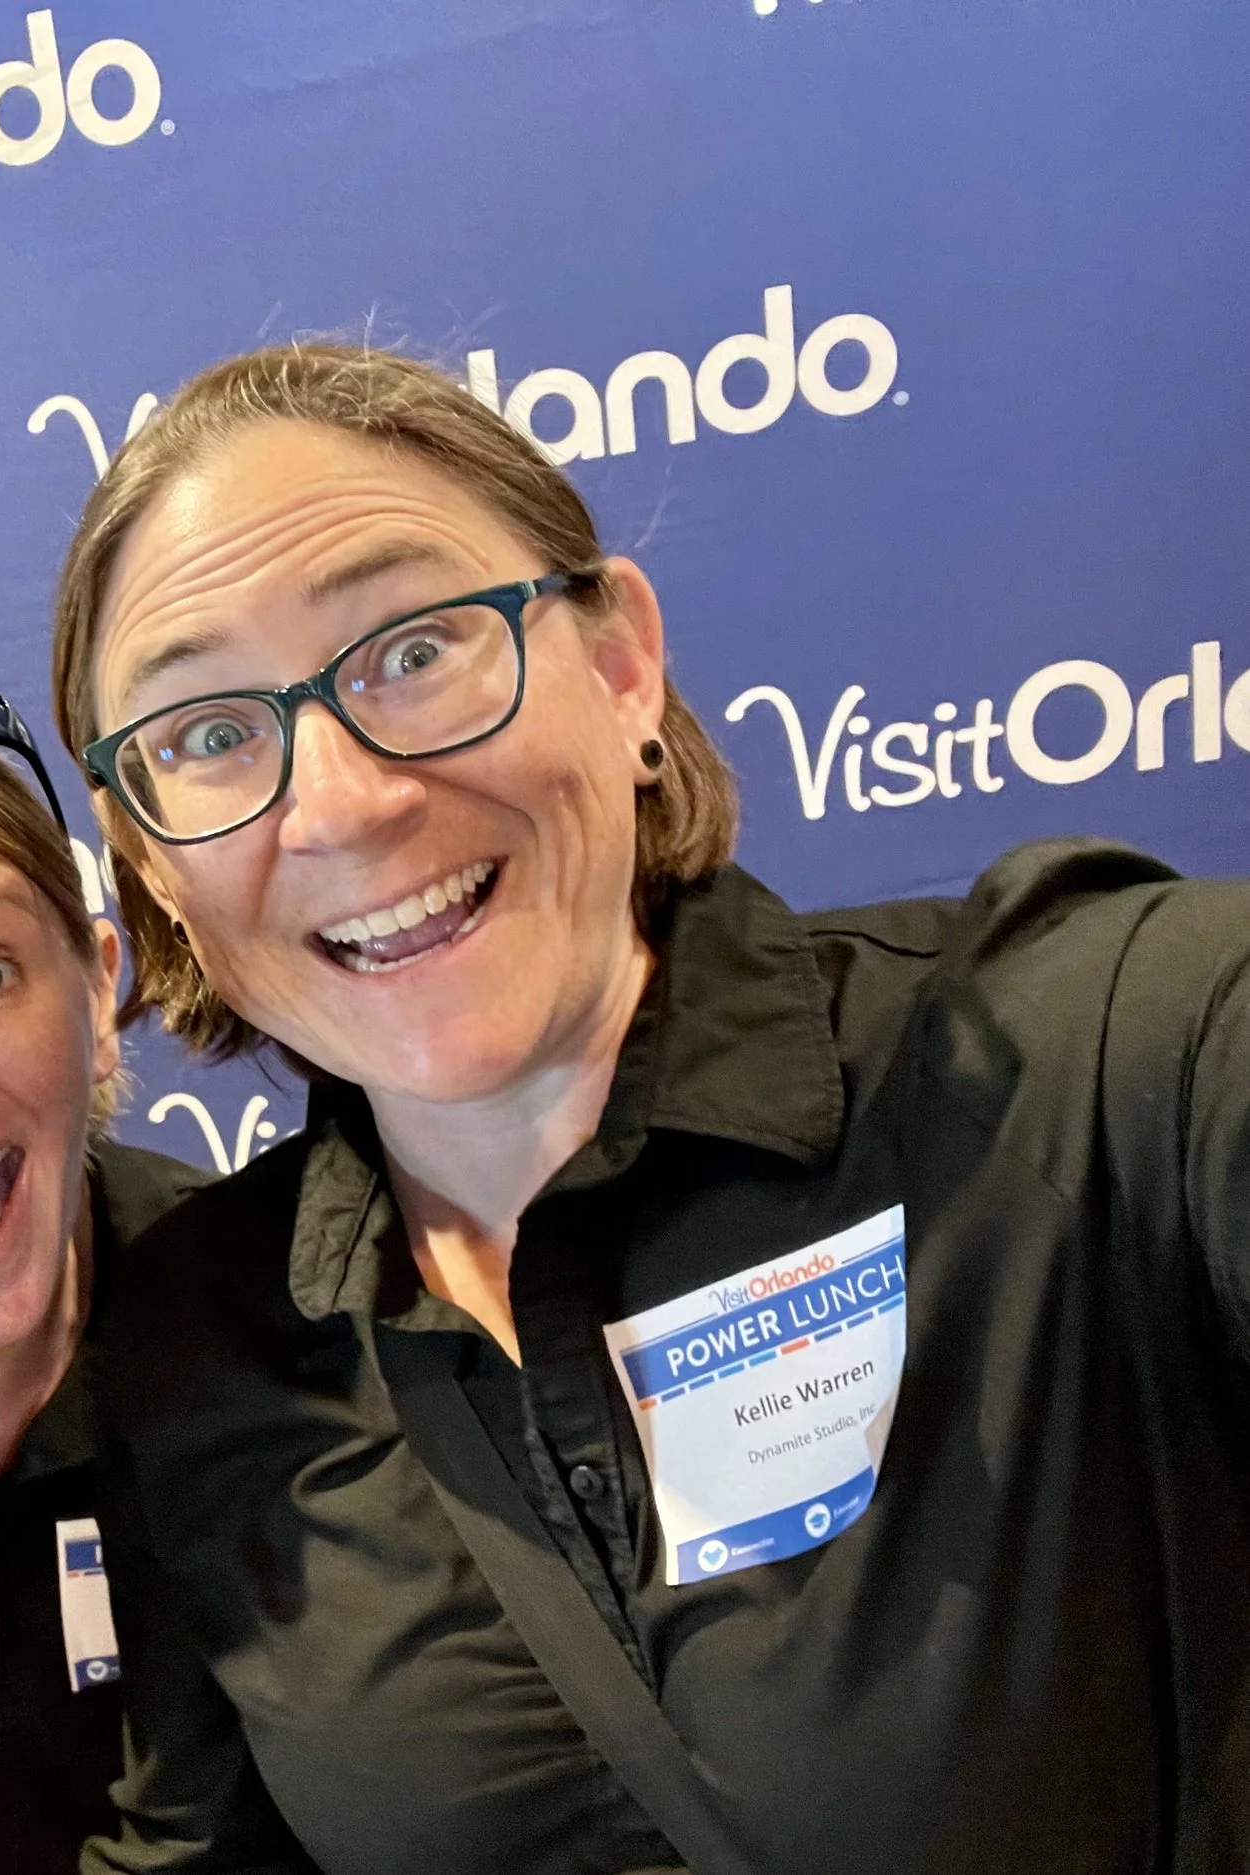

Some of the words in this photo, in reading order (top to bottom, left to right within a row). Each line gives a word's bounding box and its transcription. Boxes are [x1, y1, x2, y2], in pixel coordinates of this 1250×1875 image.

[725, 641, 1250, 820] VisitOrl
[665, 1309, 782, 1377] POWER
[788, 1255, 905, 1328] LUNCH
[734, 1393, 793, 1427] Kellie
[795, 1360, 874, 1402] Warren
[747, 1433, 812, 1465] Dynamite
